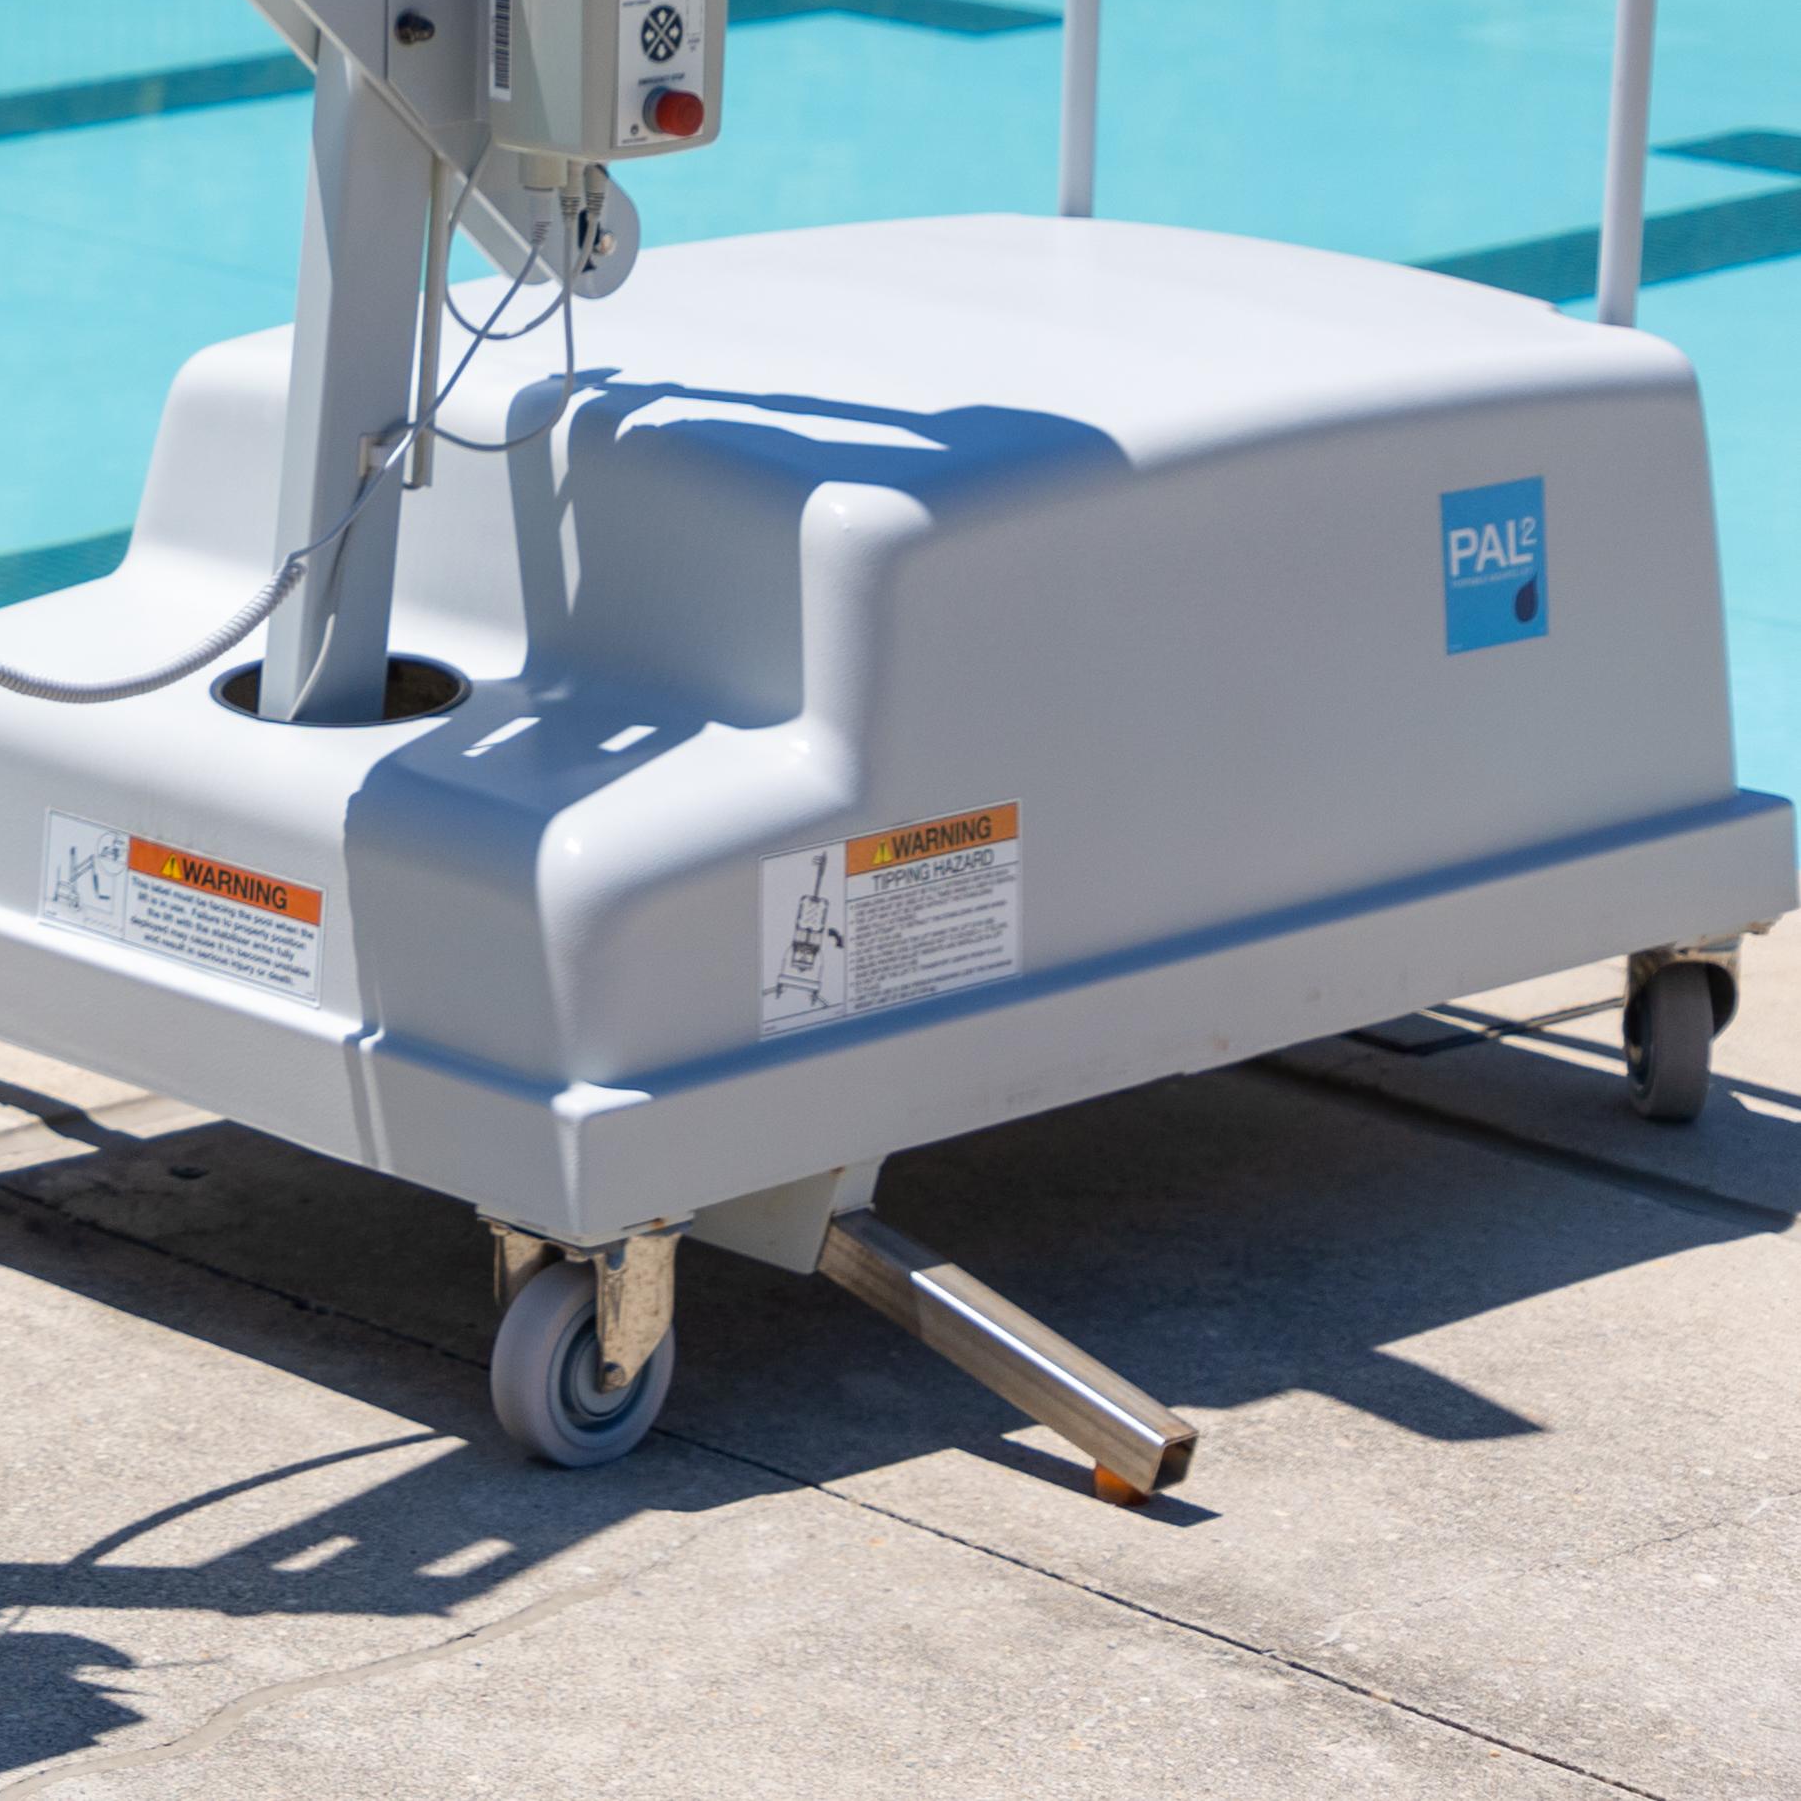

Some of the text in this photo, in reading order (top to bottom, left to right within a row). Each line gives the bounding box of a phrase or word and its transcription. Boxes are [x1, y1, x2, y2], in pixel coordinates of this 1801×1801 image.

[891, 814, 991, 859] WARNING
[181, 857, 288, 911] WARNING
[872, 847, 994, 892] TIPPING HAZARD
